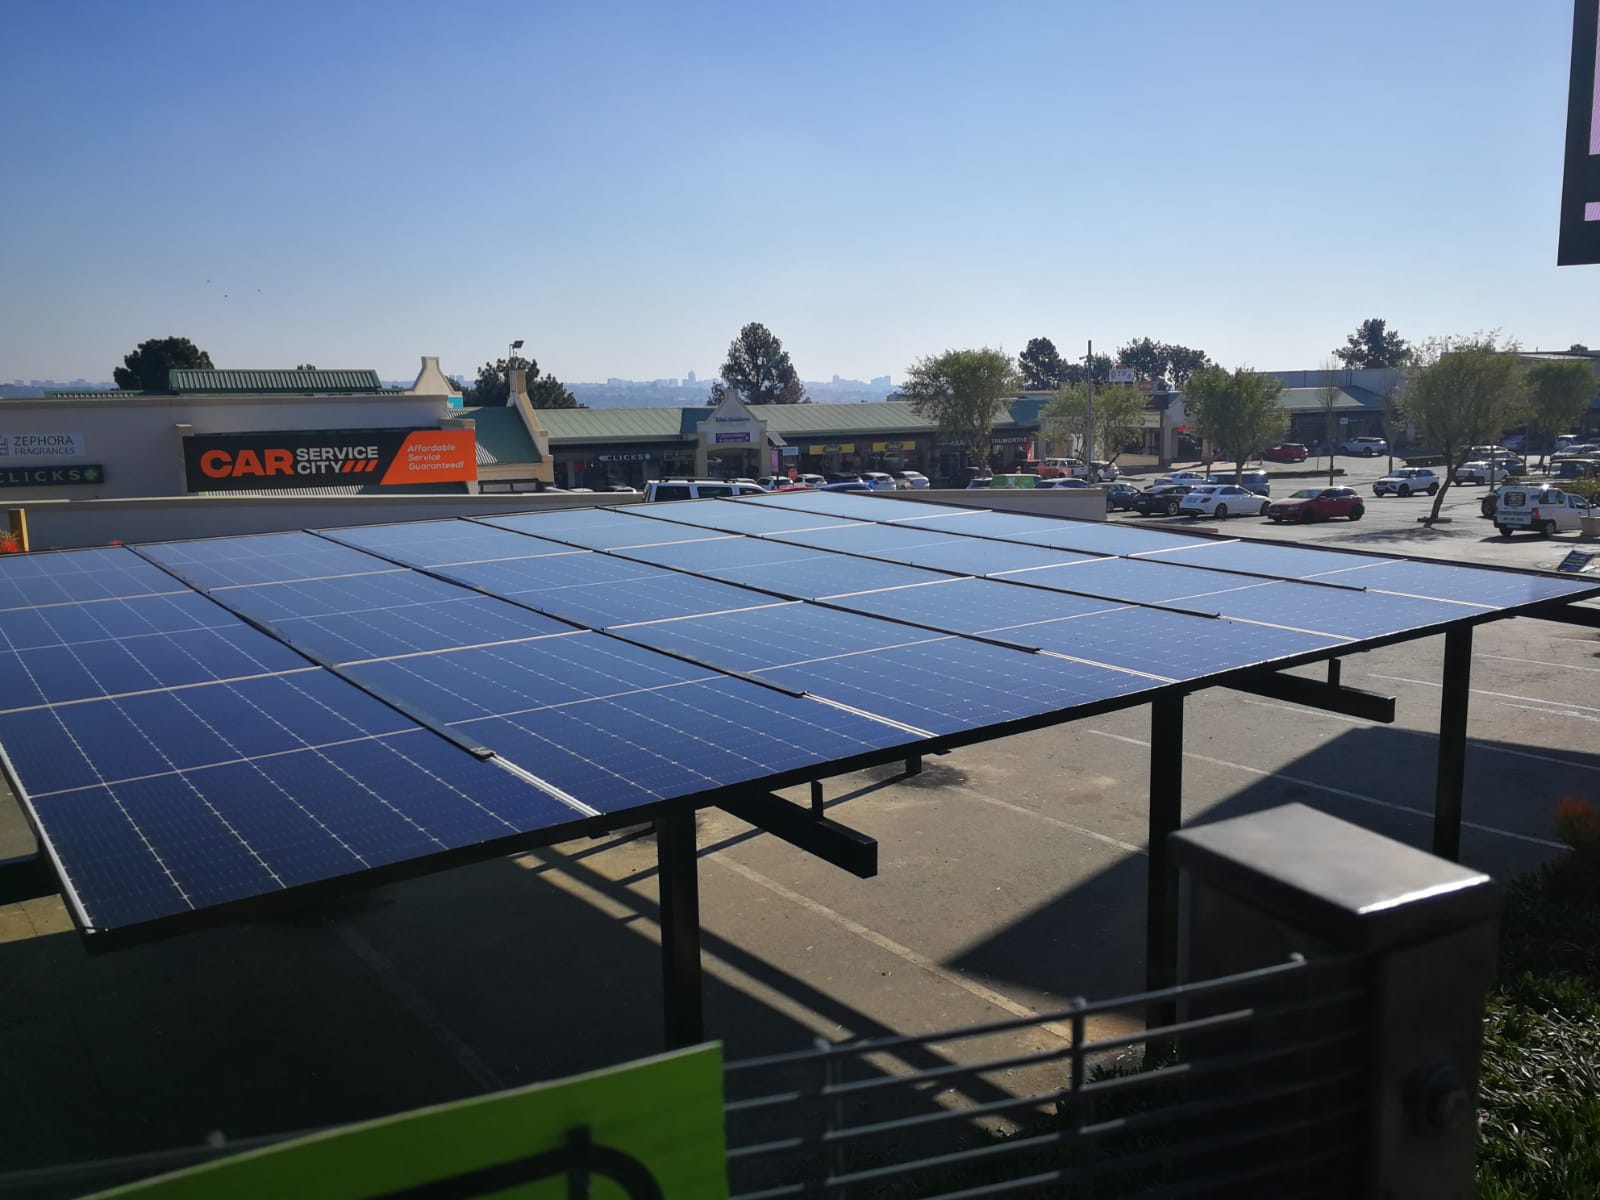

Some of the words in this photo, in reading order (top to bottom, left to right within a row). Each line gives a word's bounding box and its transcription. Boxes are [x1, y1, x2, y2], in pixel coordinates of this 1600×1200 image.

[14, 434, 74, 447] ZEPHORA
[14, 447, 76, 456] FRAGRANCES
[296, 446, 379, 461] SERVICE
[408, 444, 456, 452] Affordable
[408, 453, 441, 461] Service
[200, 449, 295, 478] CAR
[297, 461, 343, 475] CITY
[408, 461, 465, 471] Guaranteed!
